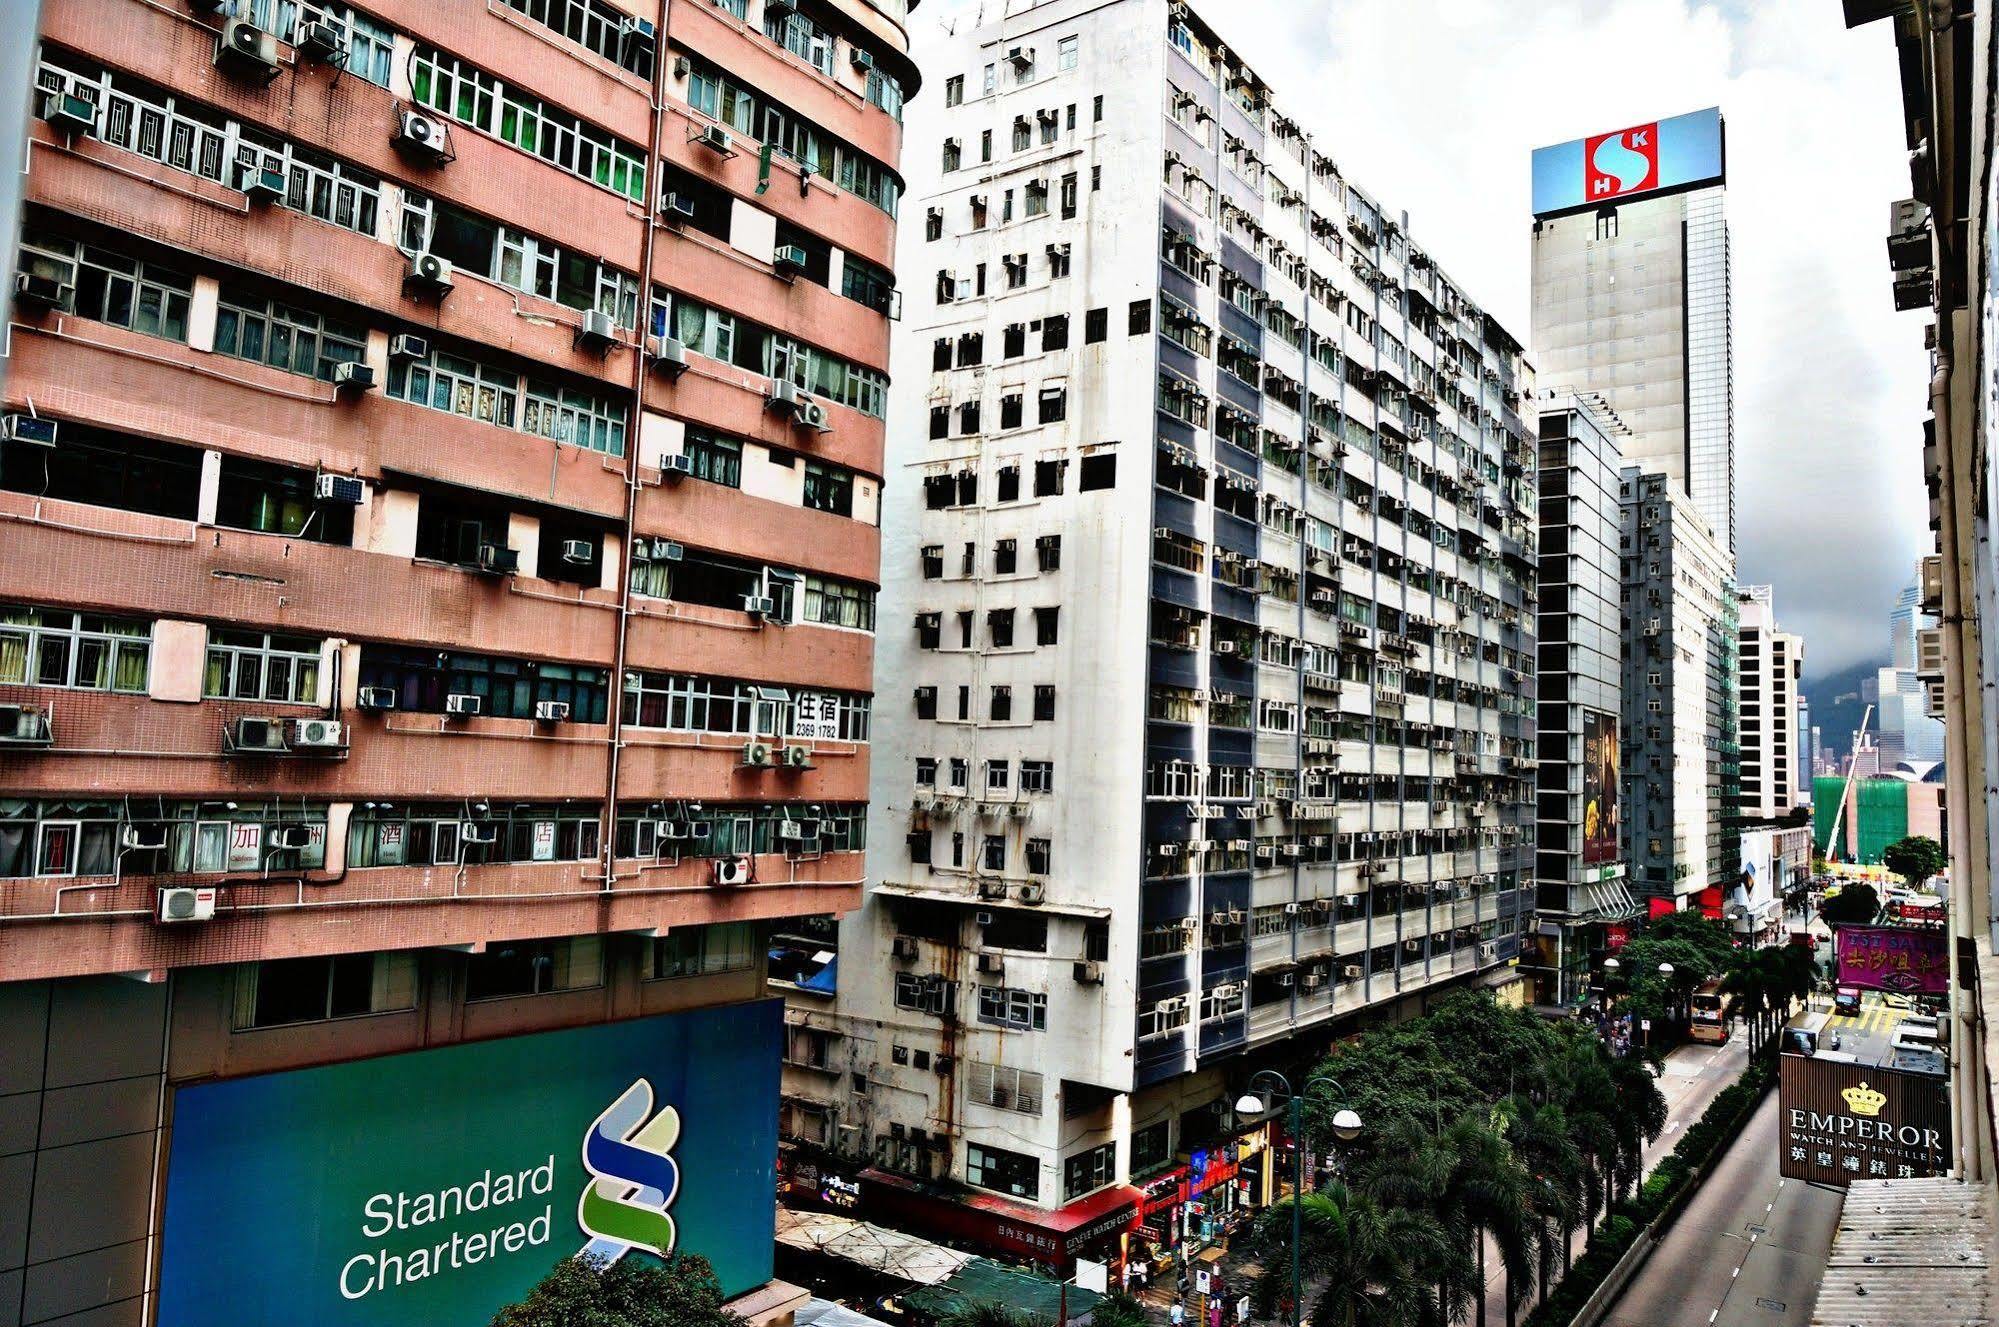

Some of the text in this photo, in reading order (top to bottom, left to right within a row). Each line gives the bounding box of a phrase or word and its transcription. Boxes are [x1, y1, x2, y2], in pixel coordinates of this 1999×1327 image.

[798, 691, 837, 721] 住宿
[797, 723, 836, 738] 2369 1782
[233, 825, 259, 848] 加
[536, 821, 553, 842] 店
[1790, 1108, 1943, 1150] EMPEROR
[1790, 1132, 1834, 1146] WATCH
[1840, 1141, 1867, 1151] AND
[362, 1154, 555, 1238] Standard
[339, 1204, 552, 1300] Chartered
